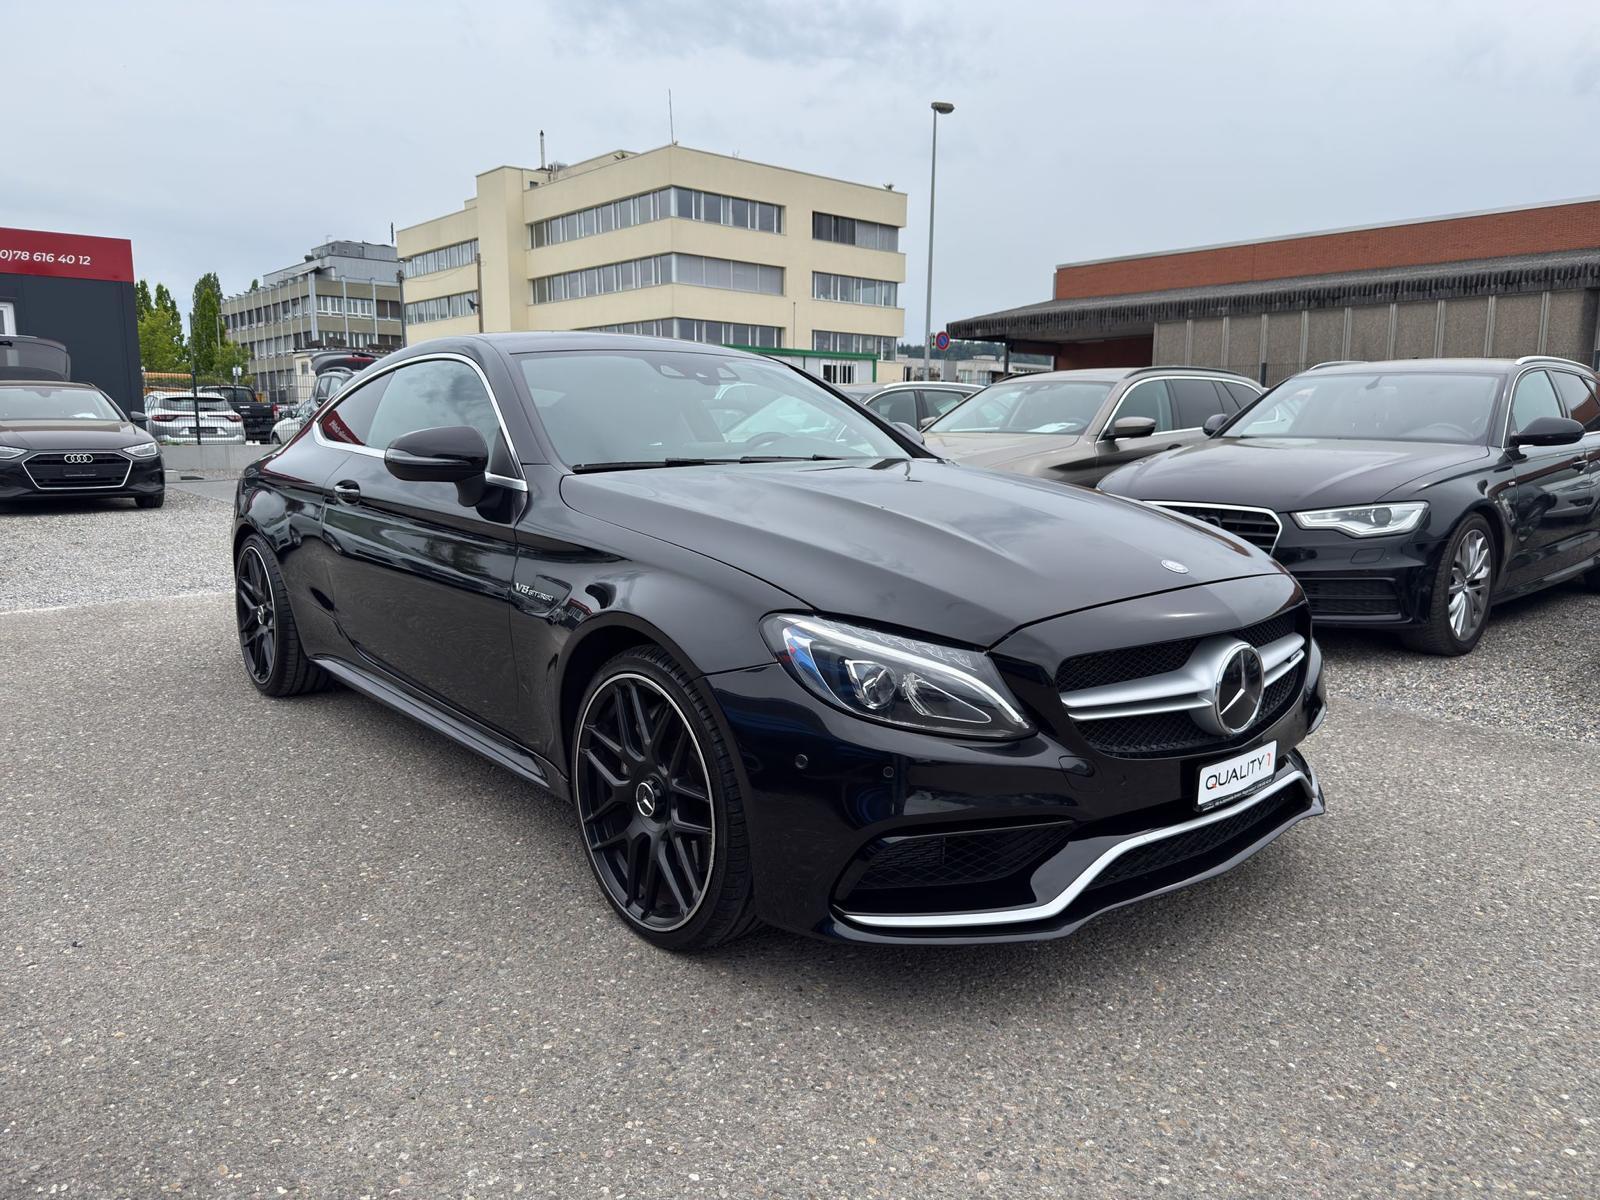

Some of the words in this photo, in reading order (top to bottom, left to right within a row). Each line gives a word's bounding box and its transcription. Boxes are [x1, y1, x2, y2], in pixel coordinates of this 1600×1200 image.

[0, 249, 30, 261] 0)78
[33, 252, 55, 263] 616
[58, 254, 75, 264] 40
[78, 255, 91, 265] 12
[515, 582, 530, 594] V8
